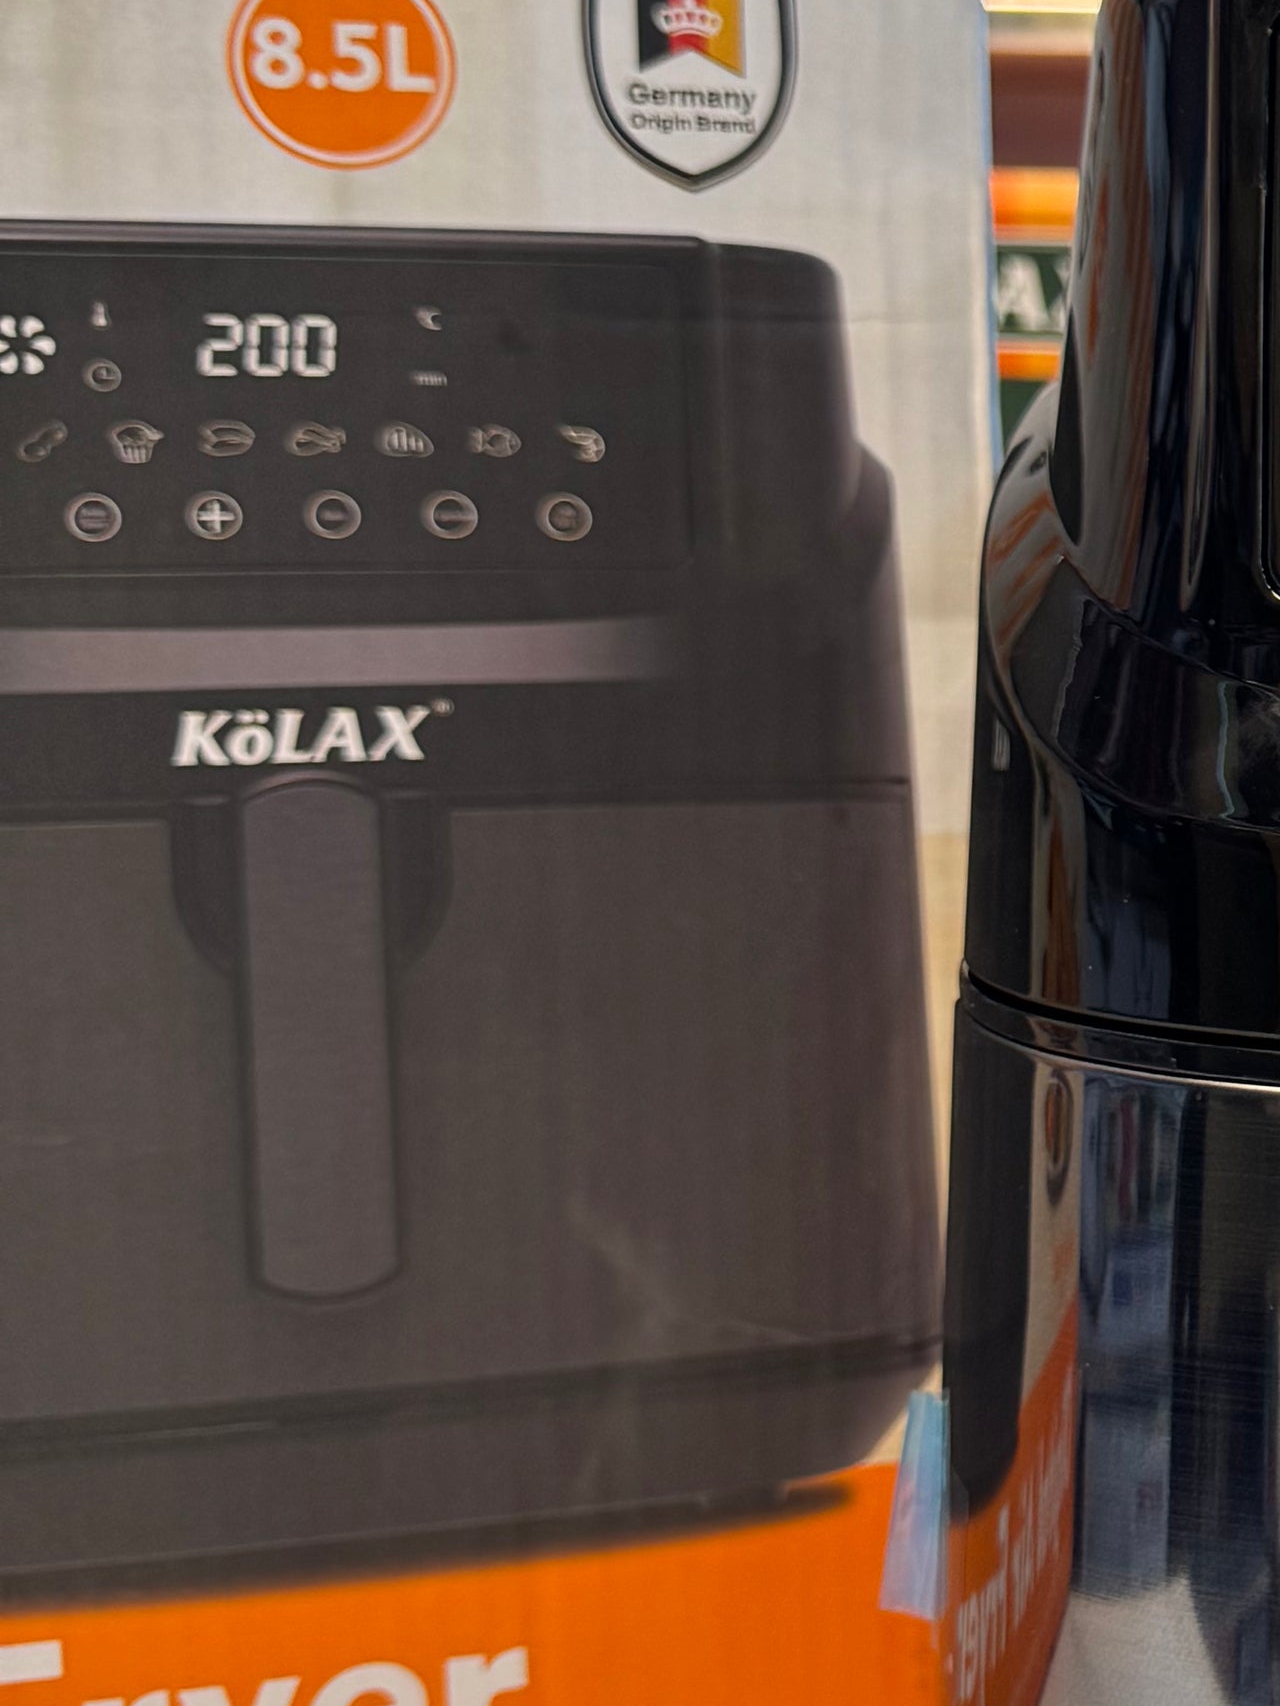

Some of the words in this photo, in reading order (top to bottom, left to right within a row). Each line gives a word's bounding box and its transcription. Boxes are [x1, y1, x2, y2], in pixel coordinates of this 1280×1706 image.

[250, 18, 435, 93] 8.5L
[628, 82, 757, 116] Germany
[631, 113, 691, 134] Origin
[697, 115, 757, 135] Brand
[197, 313, 339, 378] 200
